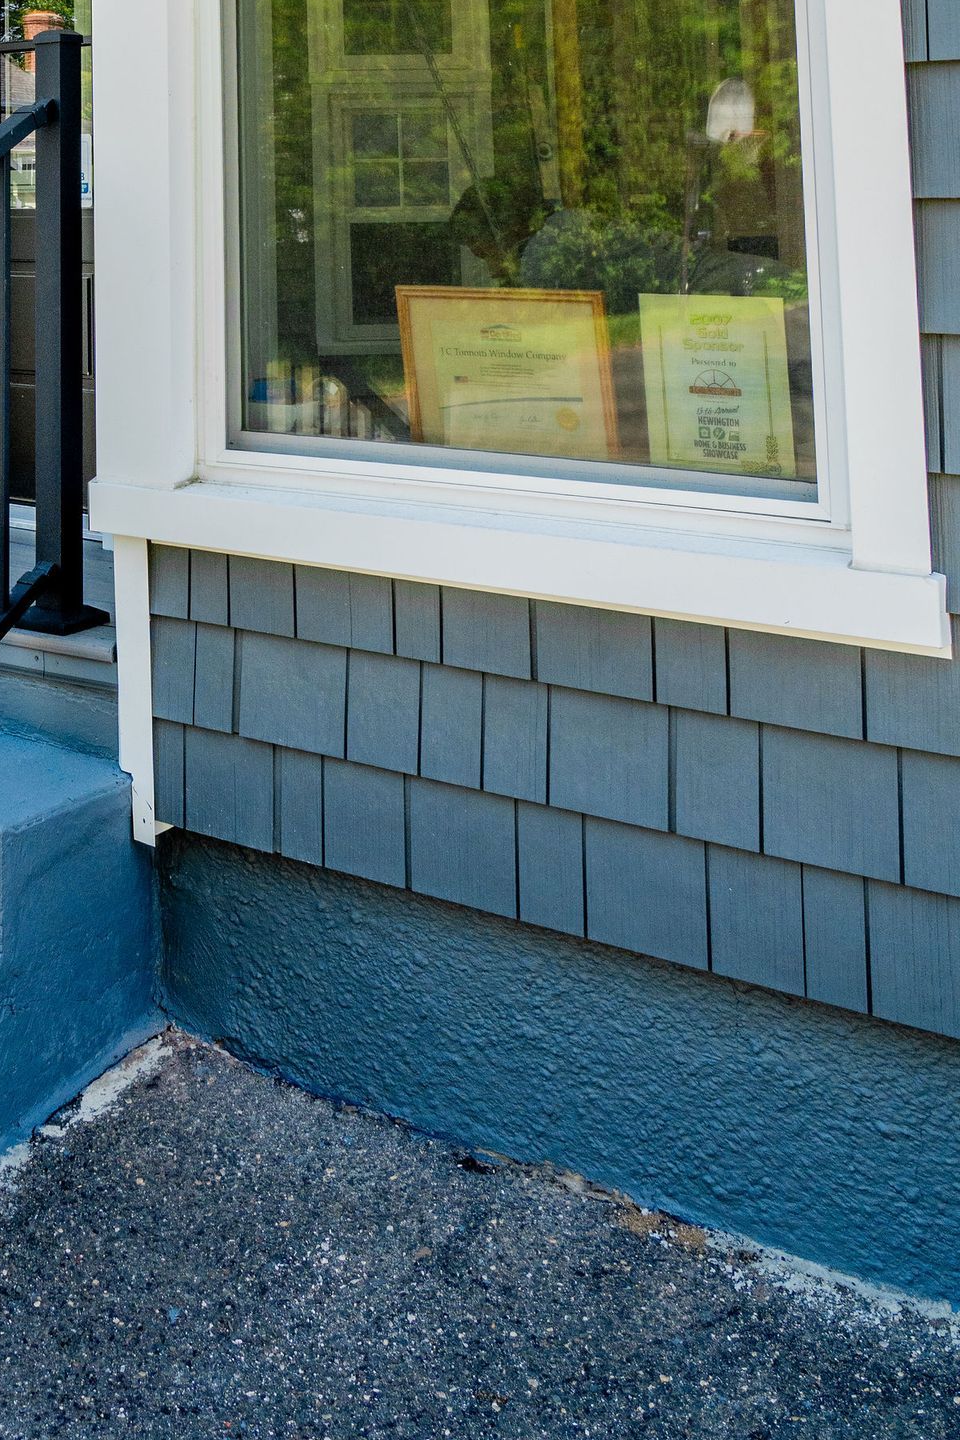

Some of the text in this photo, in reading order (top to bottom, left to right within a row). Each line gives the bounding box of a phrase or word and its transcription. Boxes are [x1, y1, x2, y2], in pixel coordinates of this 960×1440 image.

[488, 348, 523, 359] Window
[525, 350, 566, 362] Company
[698, 416, 739, 427] NEWINGTON
[718, 441, 747, 451] BUSINESS
[703, 449, 738, 460] SHOWCASE
